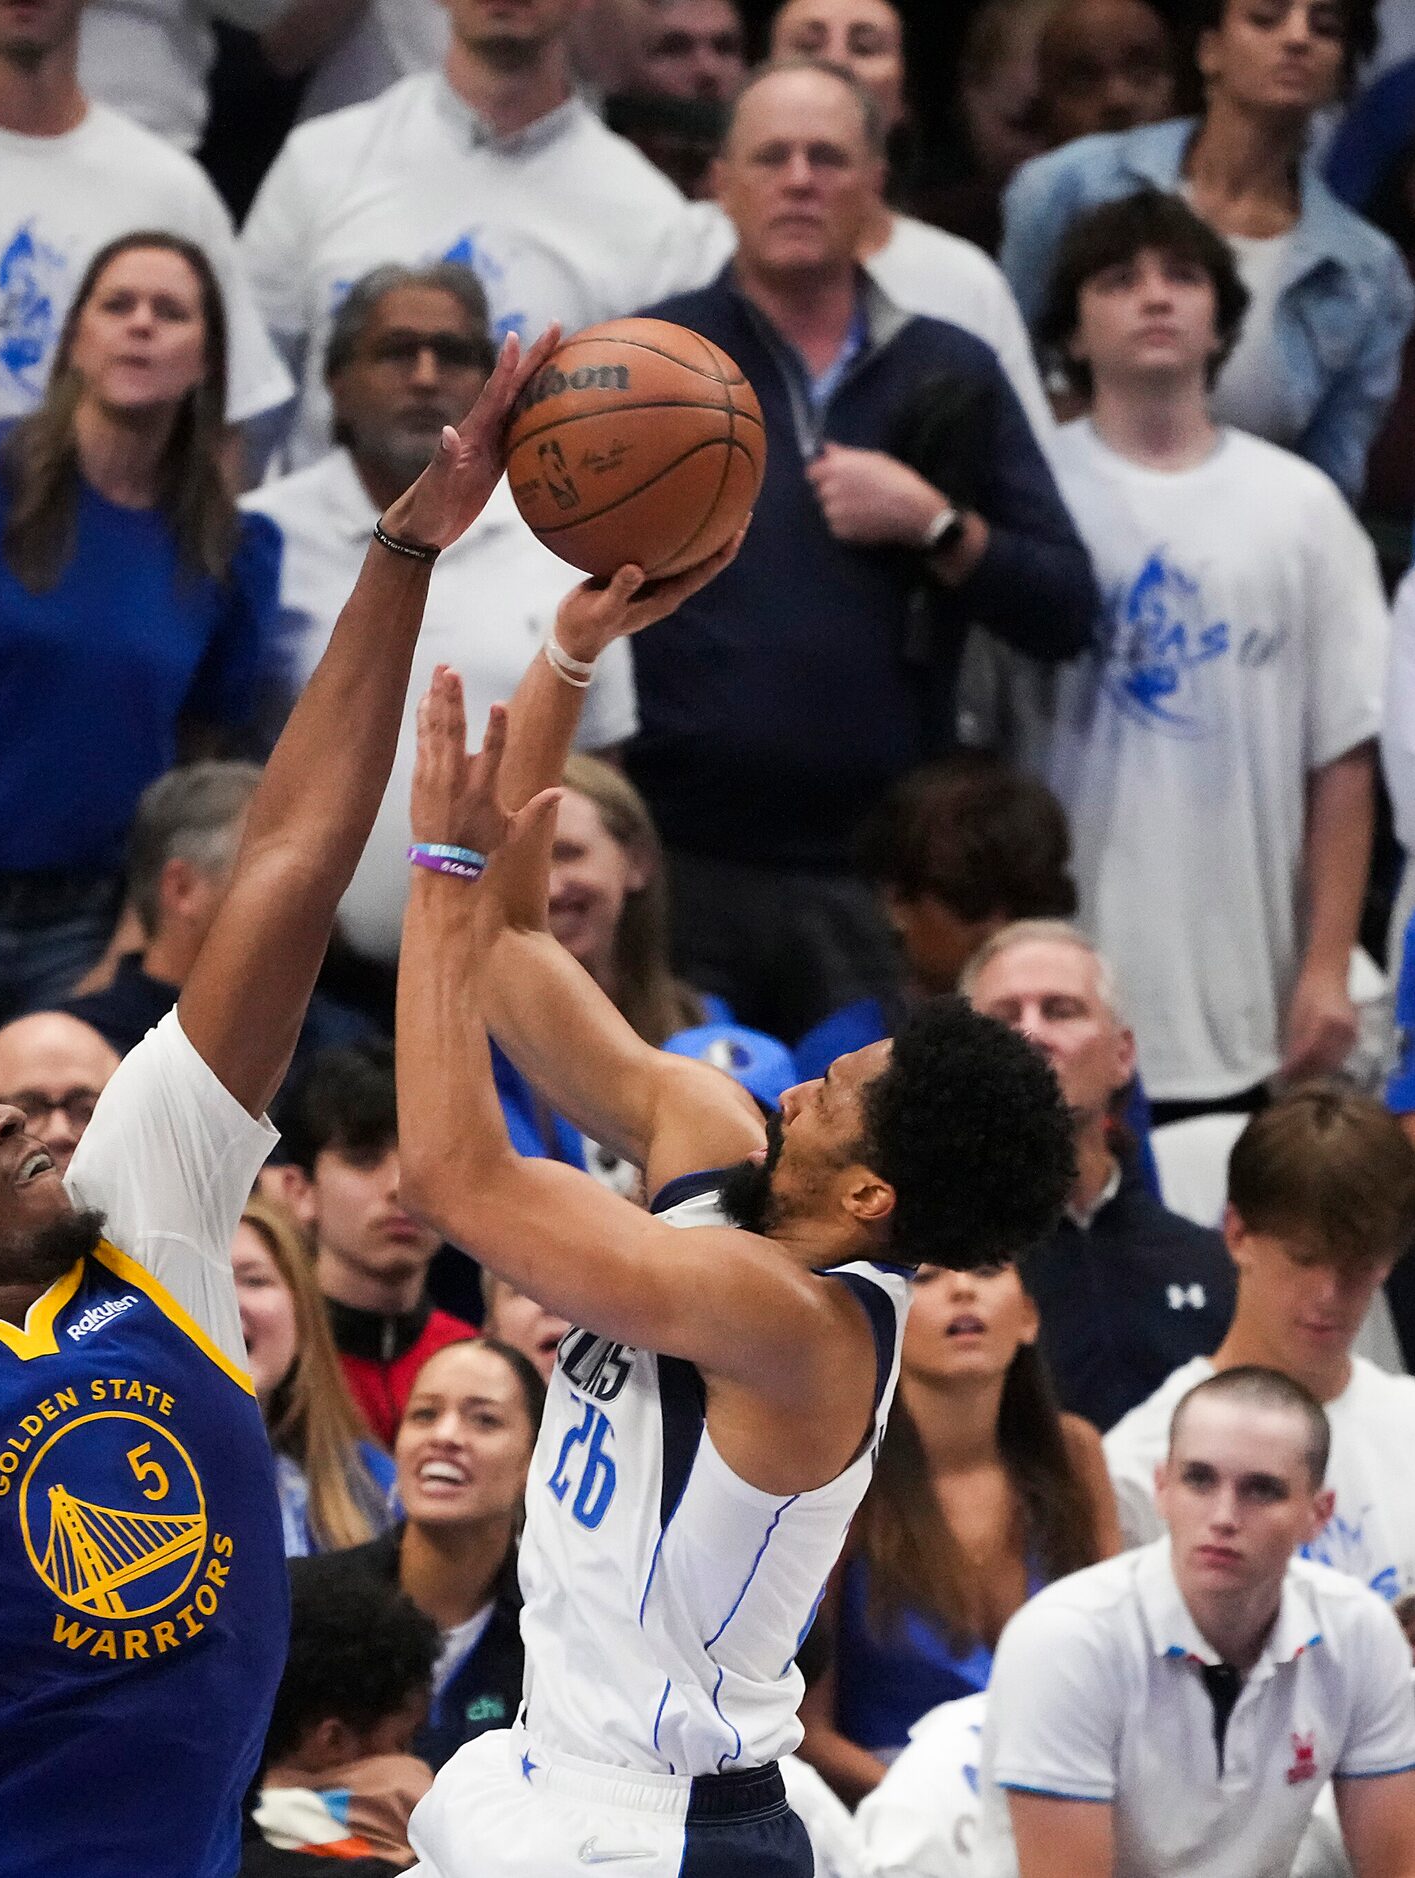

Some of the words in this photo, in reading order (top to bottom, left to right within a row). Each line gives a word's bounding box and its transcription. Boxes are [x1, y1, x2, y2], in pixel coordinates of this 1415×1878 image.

[66, 1294, 140, 1342] Rakuten
[90, 1379, 177, 1417] STATE
[126, 1440, 170, 1502] 5
[546, 1390, 618, 1532] 26
[52, 1532, 235, 1661] WARRIORS
